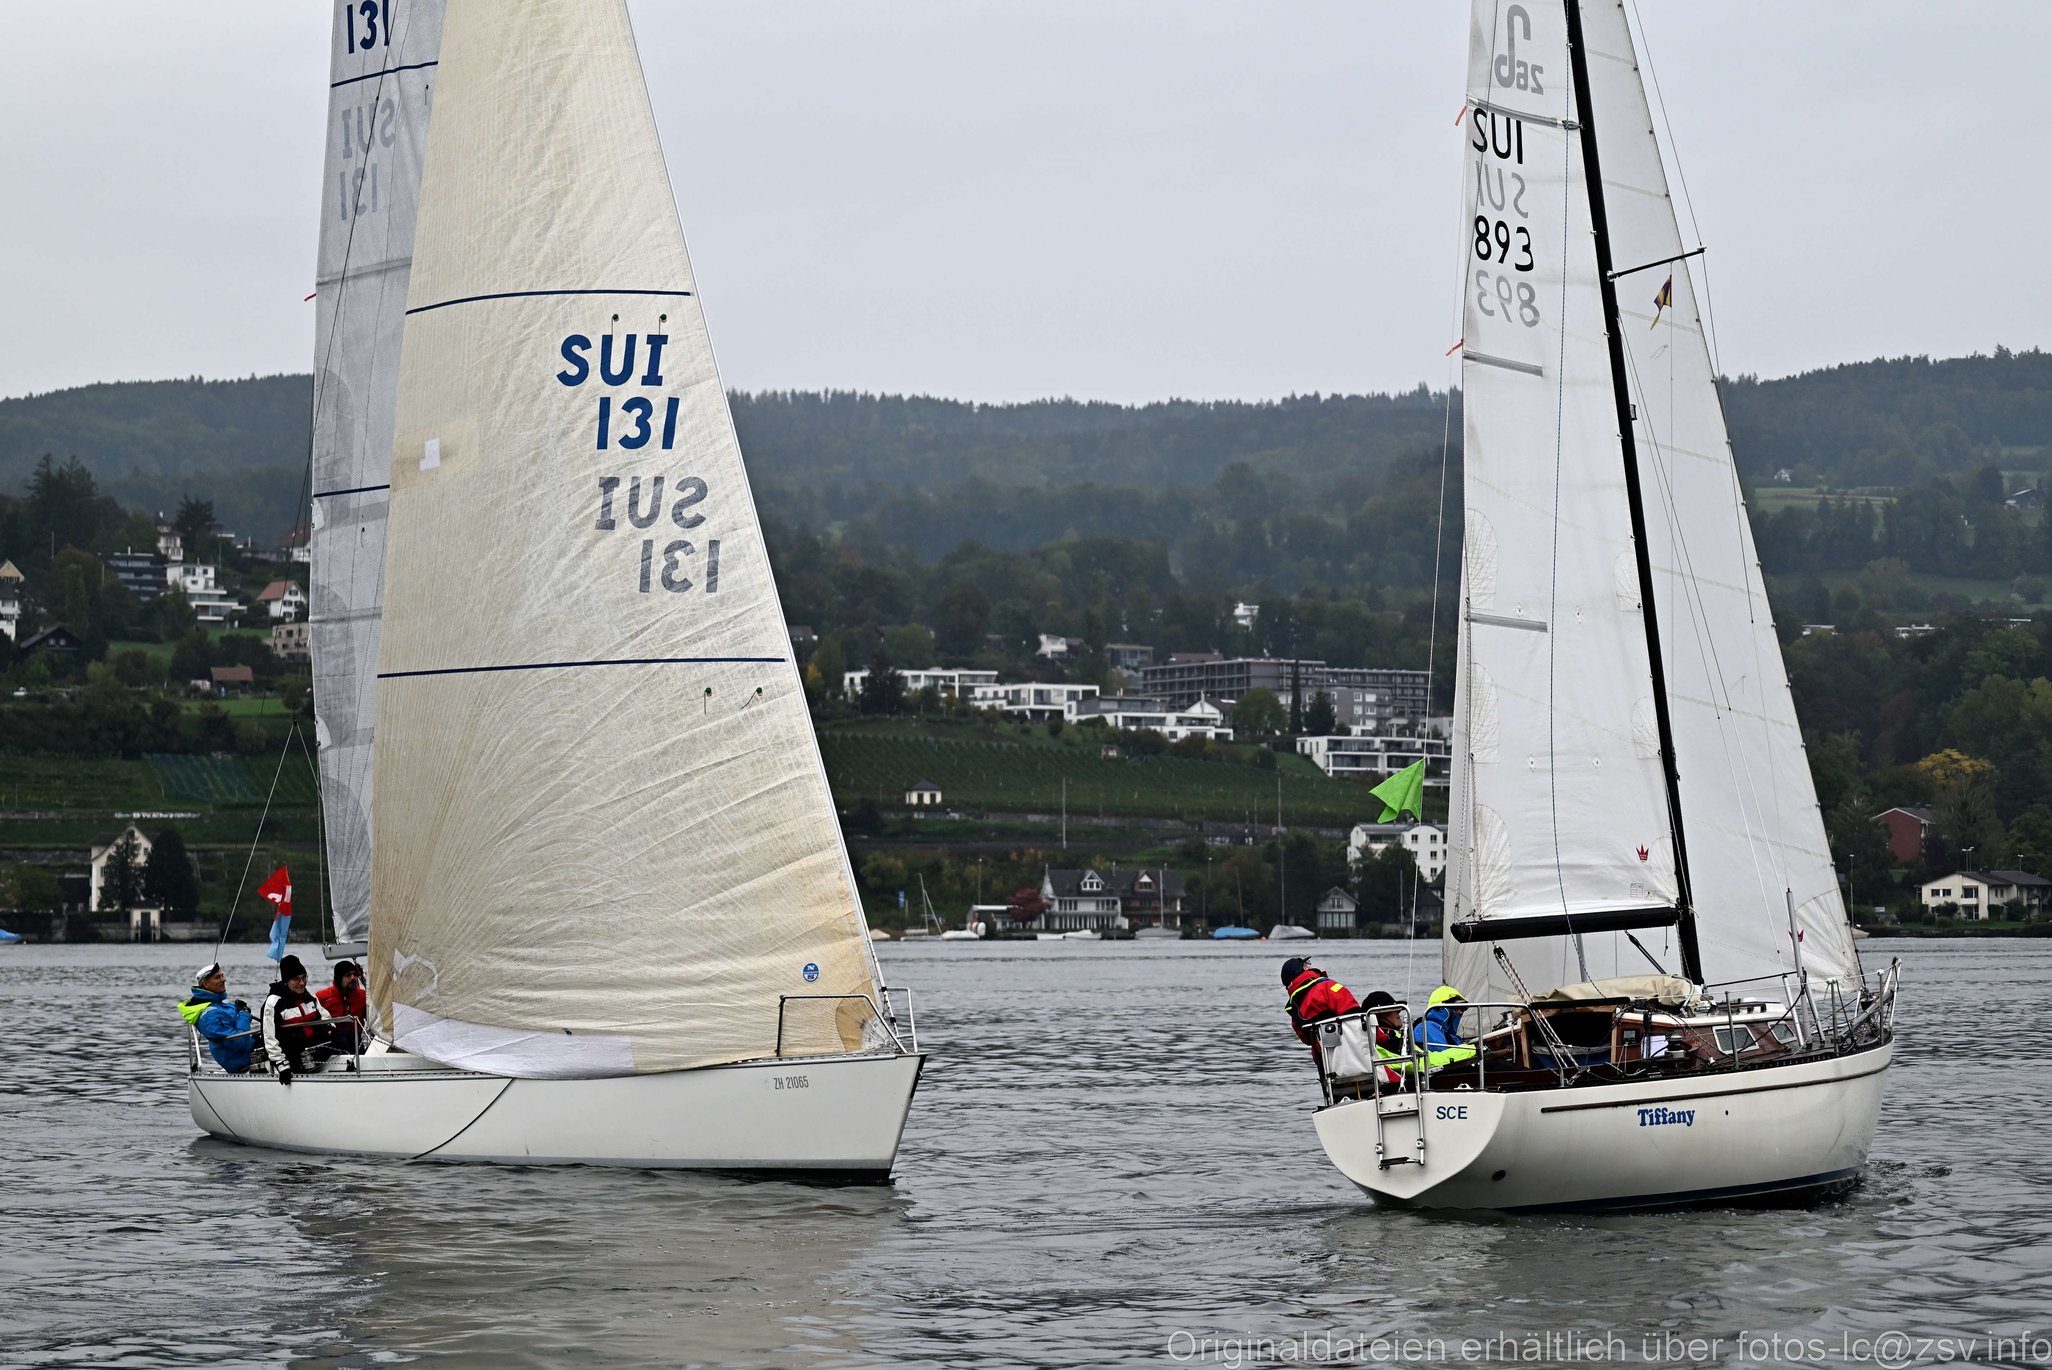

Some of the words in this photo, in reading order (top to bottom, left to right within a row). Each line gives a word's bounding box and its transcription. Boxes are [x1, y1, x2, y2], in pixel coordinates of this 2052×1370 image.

[347, 0, 390, 54] 131
[1472, 108, 1523, 164] SUI
[1474, 215, 1534, 272] 893
[556, 333, 669, 386] SUI
[597, 396, 680, 450] 131
[773, 1077, 784, 1089] ZH
[786, 1075, 809, 1089] 21065
[1436, 1106, 1468, 1120] SCE
[1637, 1107, 1695, 1127] Tiffany
